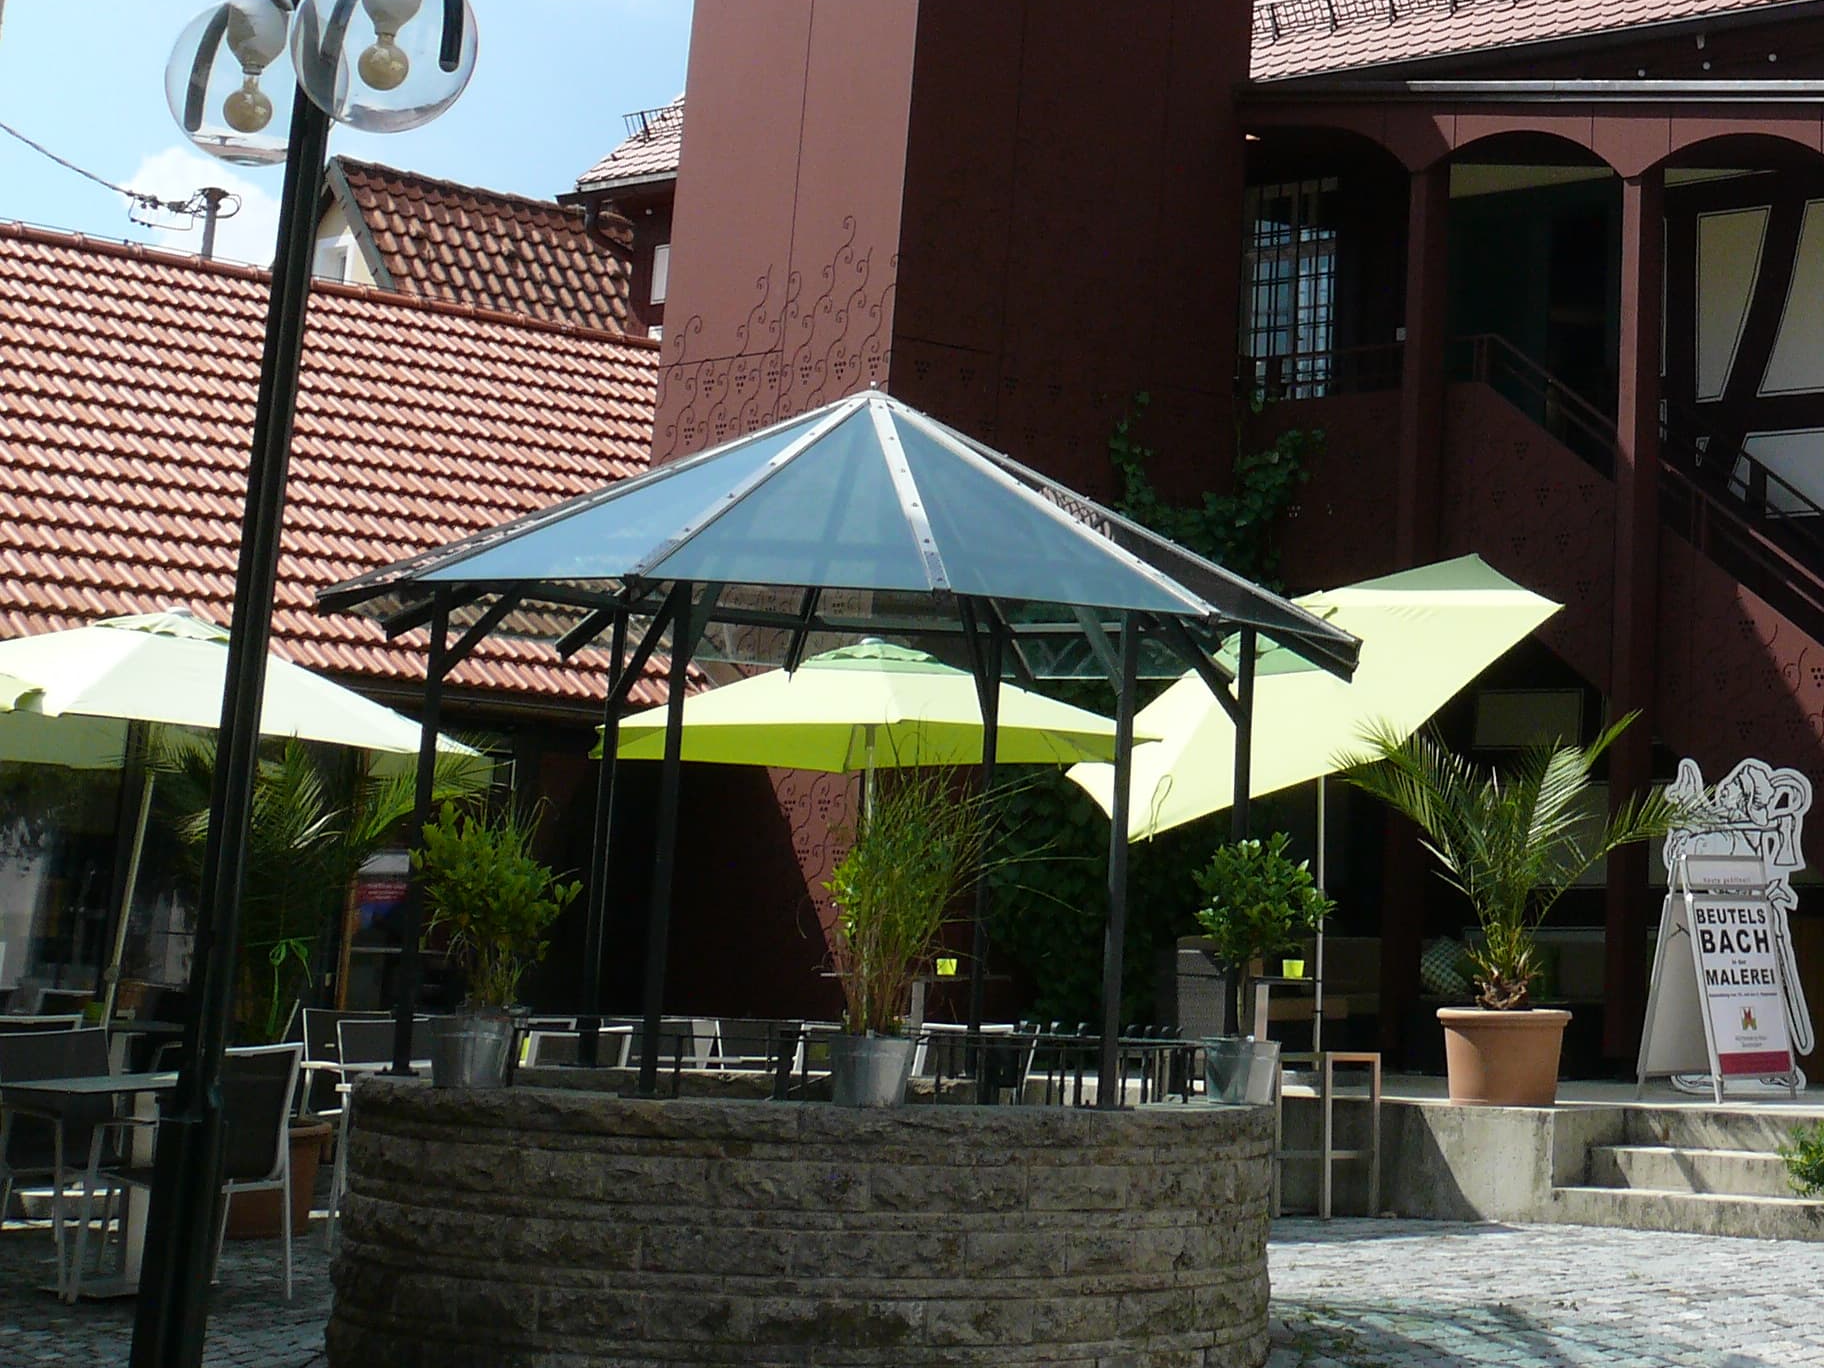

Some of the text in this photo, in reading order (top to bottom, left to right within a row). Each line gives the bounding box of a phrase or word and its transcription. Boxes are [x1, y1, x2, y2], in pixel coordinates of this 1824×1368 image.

[1696, 908, 1766, 924] BEUTELS
[1700, 929, 1770, 954] BACH
[1705, 968, 1776, 986] MALEREI
